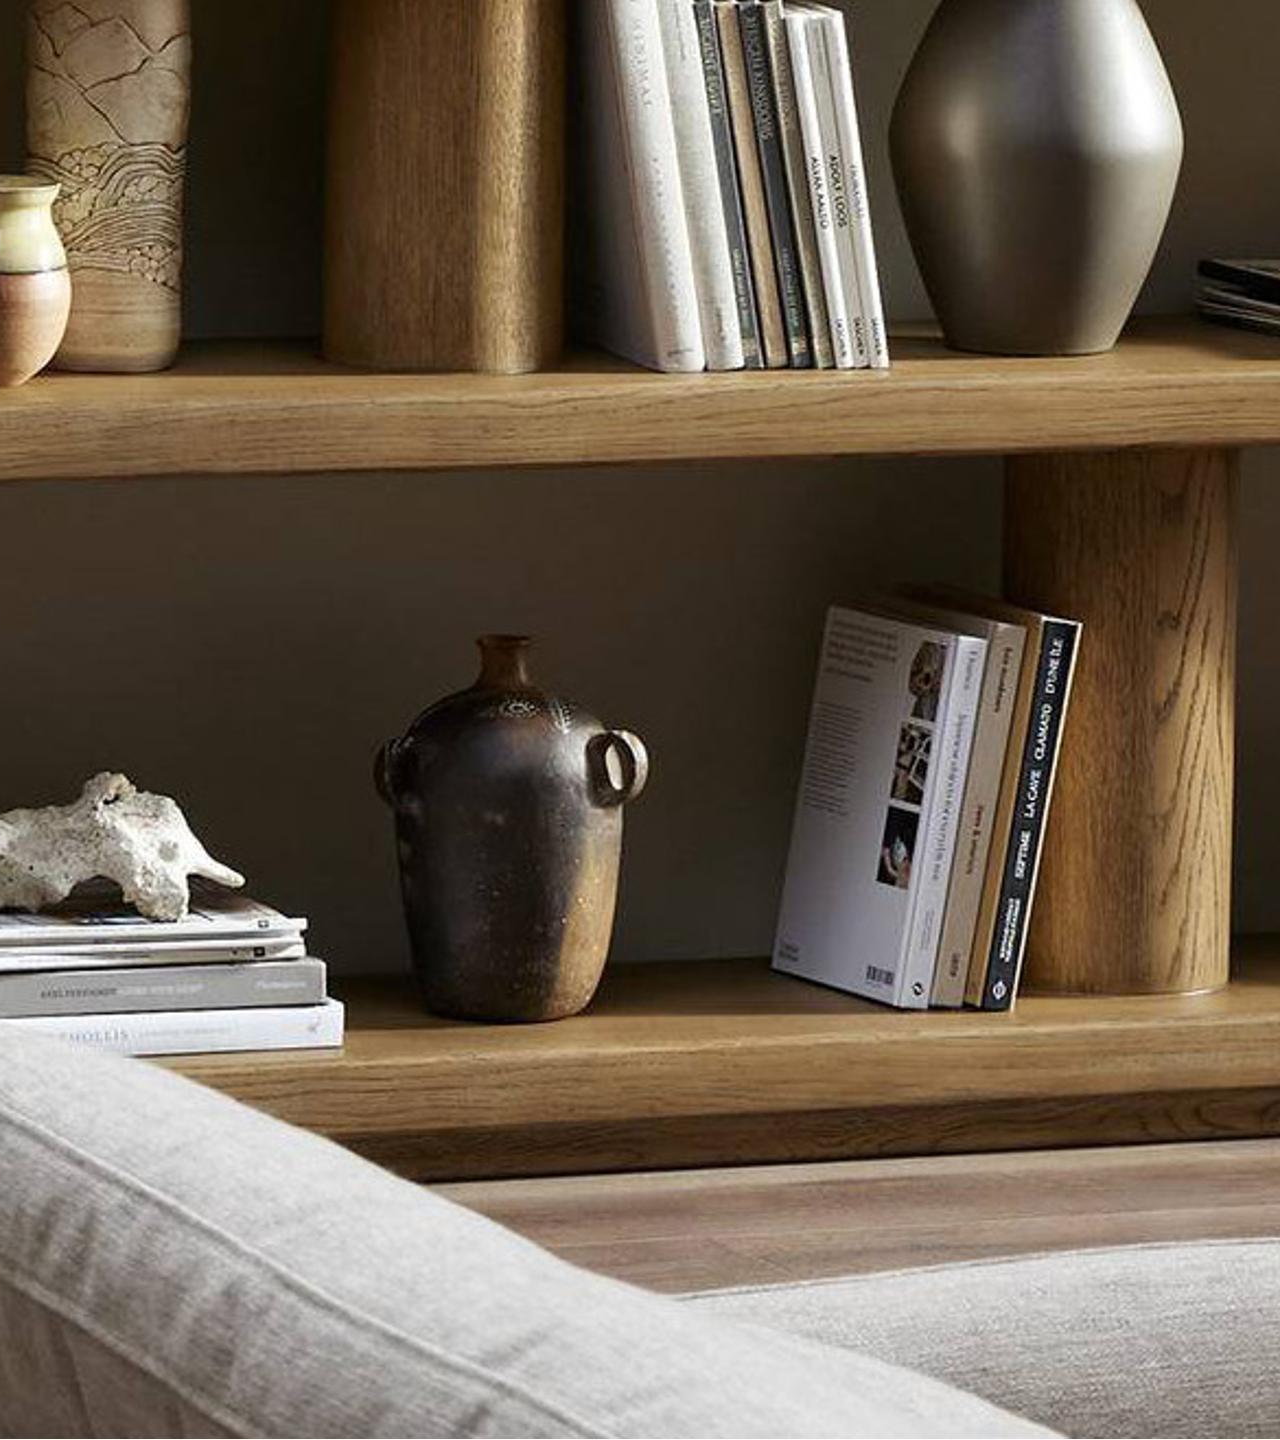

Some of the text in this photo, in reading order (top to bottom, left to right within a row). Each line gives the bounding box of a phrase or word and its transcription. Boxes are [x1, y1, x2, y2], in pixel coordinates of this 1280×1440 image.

[828, 154, 848, 229] ADOLF LOOS
[1026, 769, 1042, 802] CAVE
[1034, 702, 1053, 761] CLAMATO
